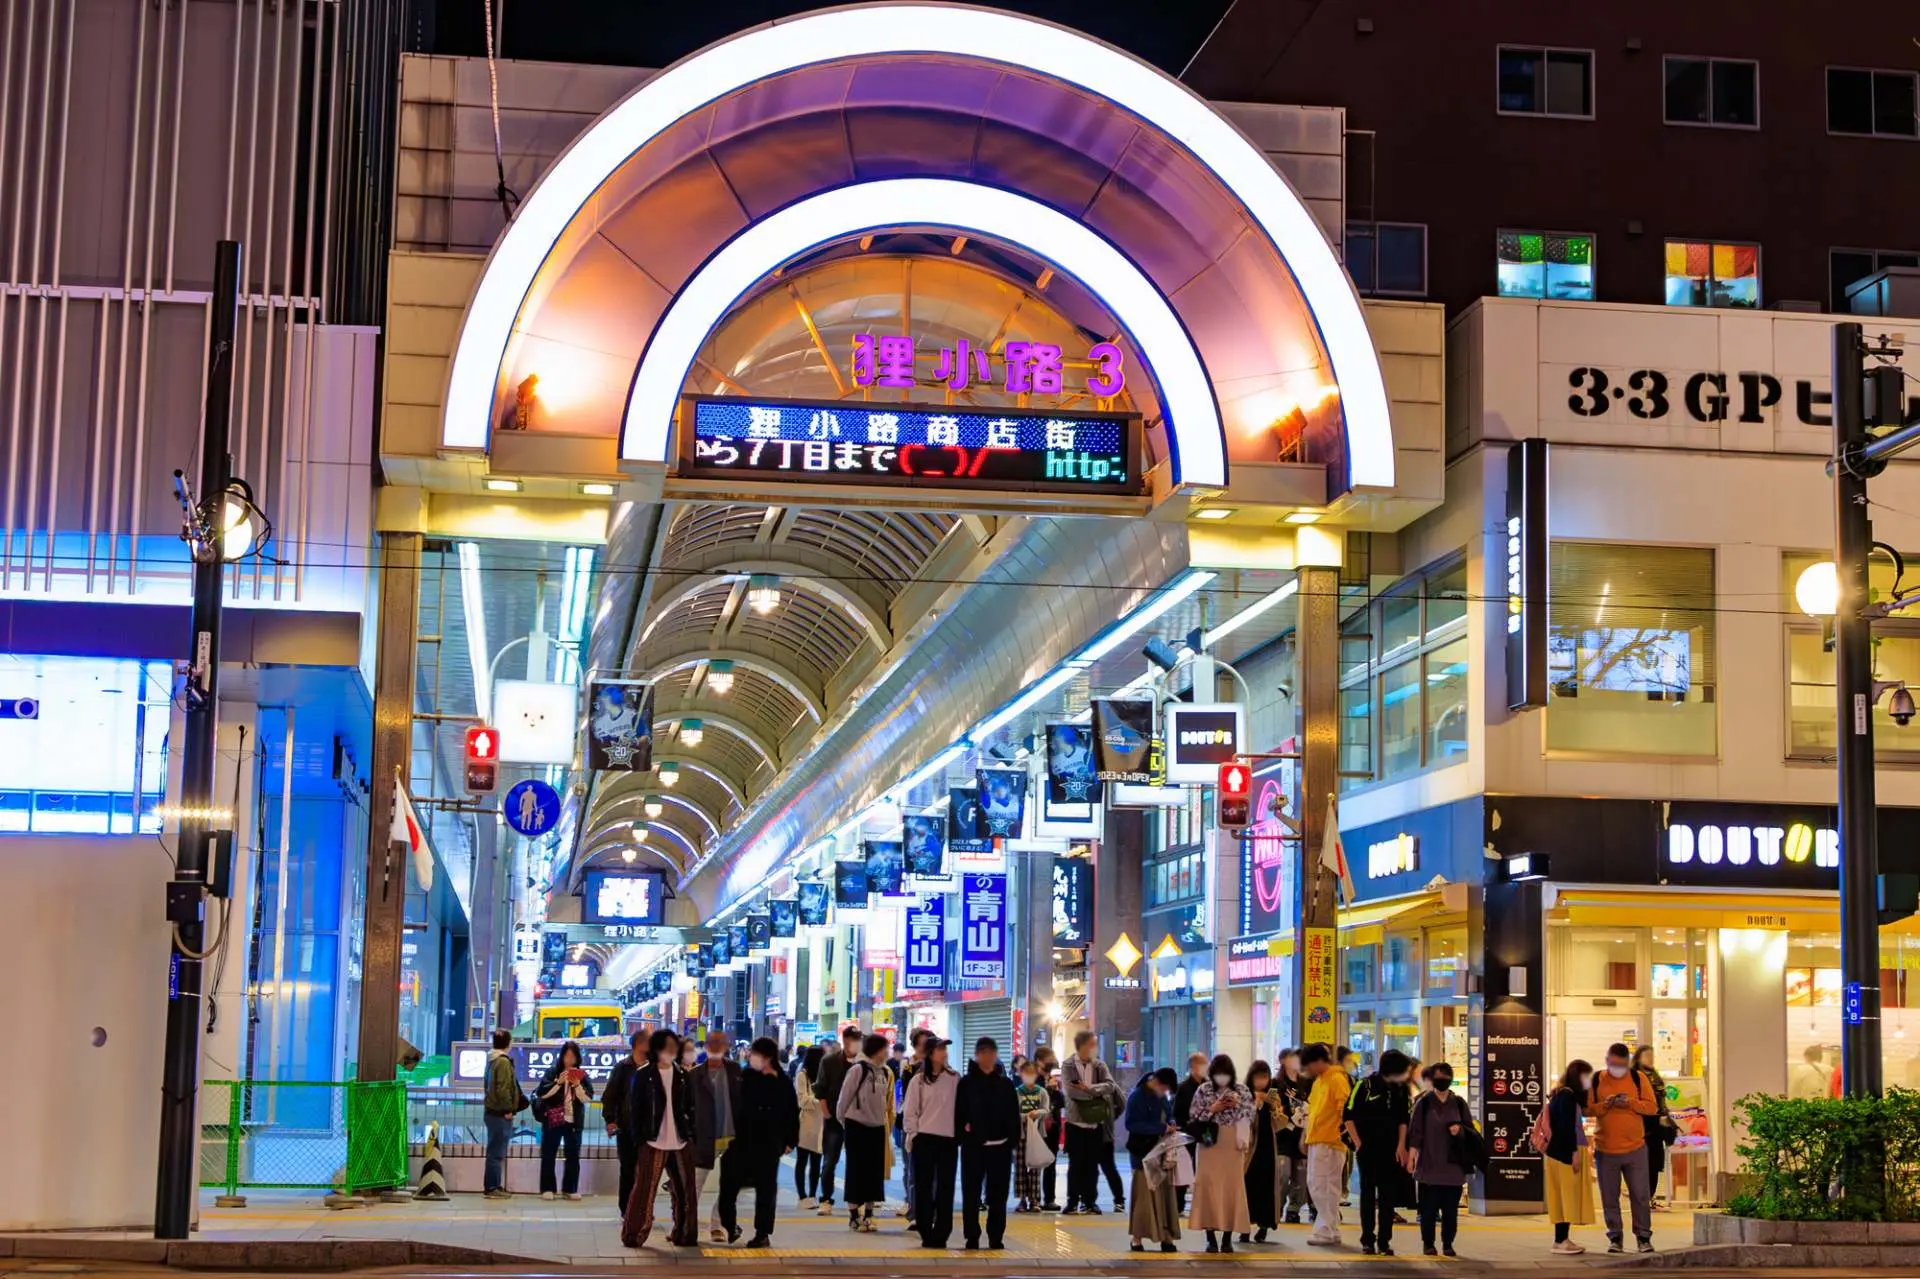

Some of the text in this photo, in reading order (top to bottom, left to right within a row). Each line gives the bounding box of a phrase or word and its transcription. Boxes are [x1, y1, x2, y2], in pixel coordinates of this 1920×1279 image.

[852, 333, 1124, 398] 狸小路3
[749, 406, 1076, 450] 狸小路商店街
[1669, 823, 1839, 868] DOUTOR
[1308, 934, 1322, 998] 通行禁止
[1488, 1035, 1539, 1045] Information
[1493, 1069, 1524, 1080] 32 13
[1494, 1127, 1508, 1137] 26
